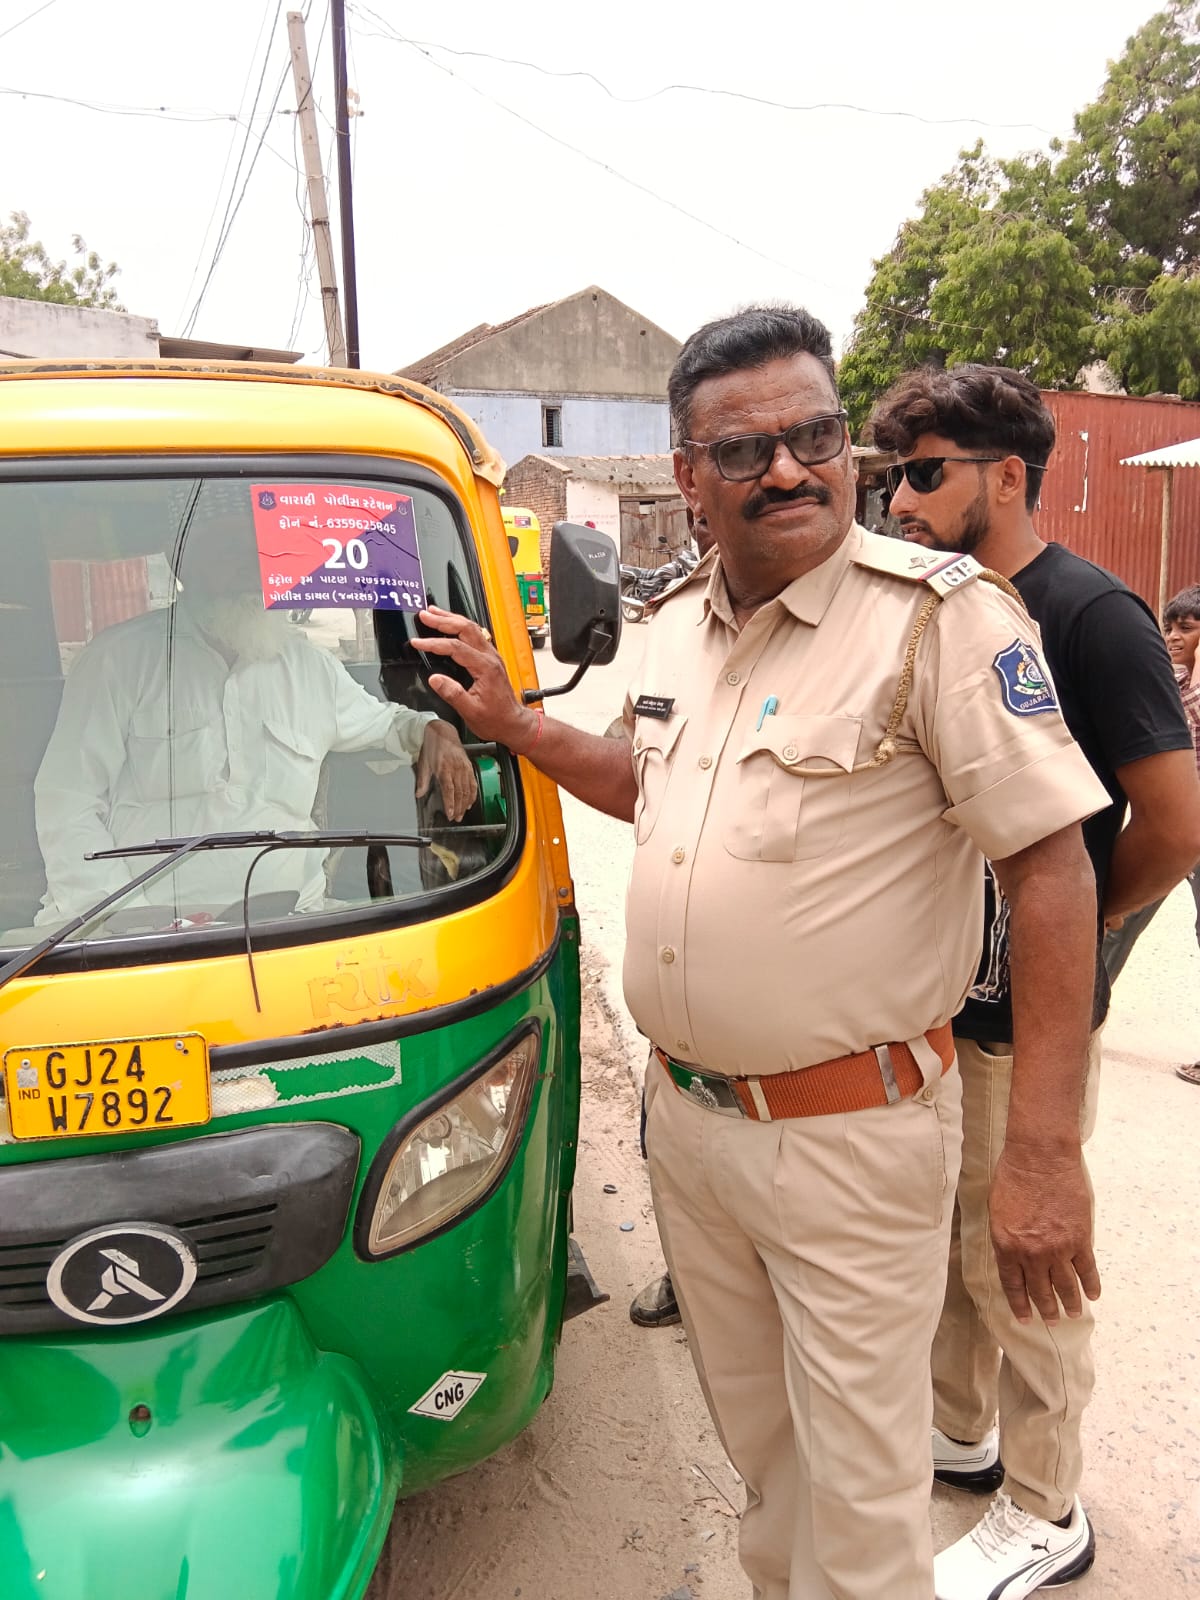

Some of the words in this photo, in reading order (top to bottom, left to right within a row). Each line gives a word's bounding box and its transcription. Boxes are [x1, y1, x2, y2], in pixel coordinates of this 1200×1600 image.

[279, 493, 316, 506] વારાહી
[323, 493, 361, 508] પોલીસ
[362, 497, 393, 512] સ્ટેશન
[279, 516, 301, 530] ફોન
[327, 518, 397, 535] 6359625845
[322, 538, 369, 570] 20
[268, 573, 293, 587] કંટ્રોલ
[300, 575, 313, 586] રૂમ
[319, 575, 348, 585] પાટણ
[269, 589, 302, 602] પોલીસ
[304, 591, 330, 602] ડાયલ
[45, 1045, 145, 1090] GJ24
[18, 1088, 41, 1101] IND
[48, 1086, 174, 1132] W7892
[434, 1382, 465, 1411] CNG
